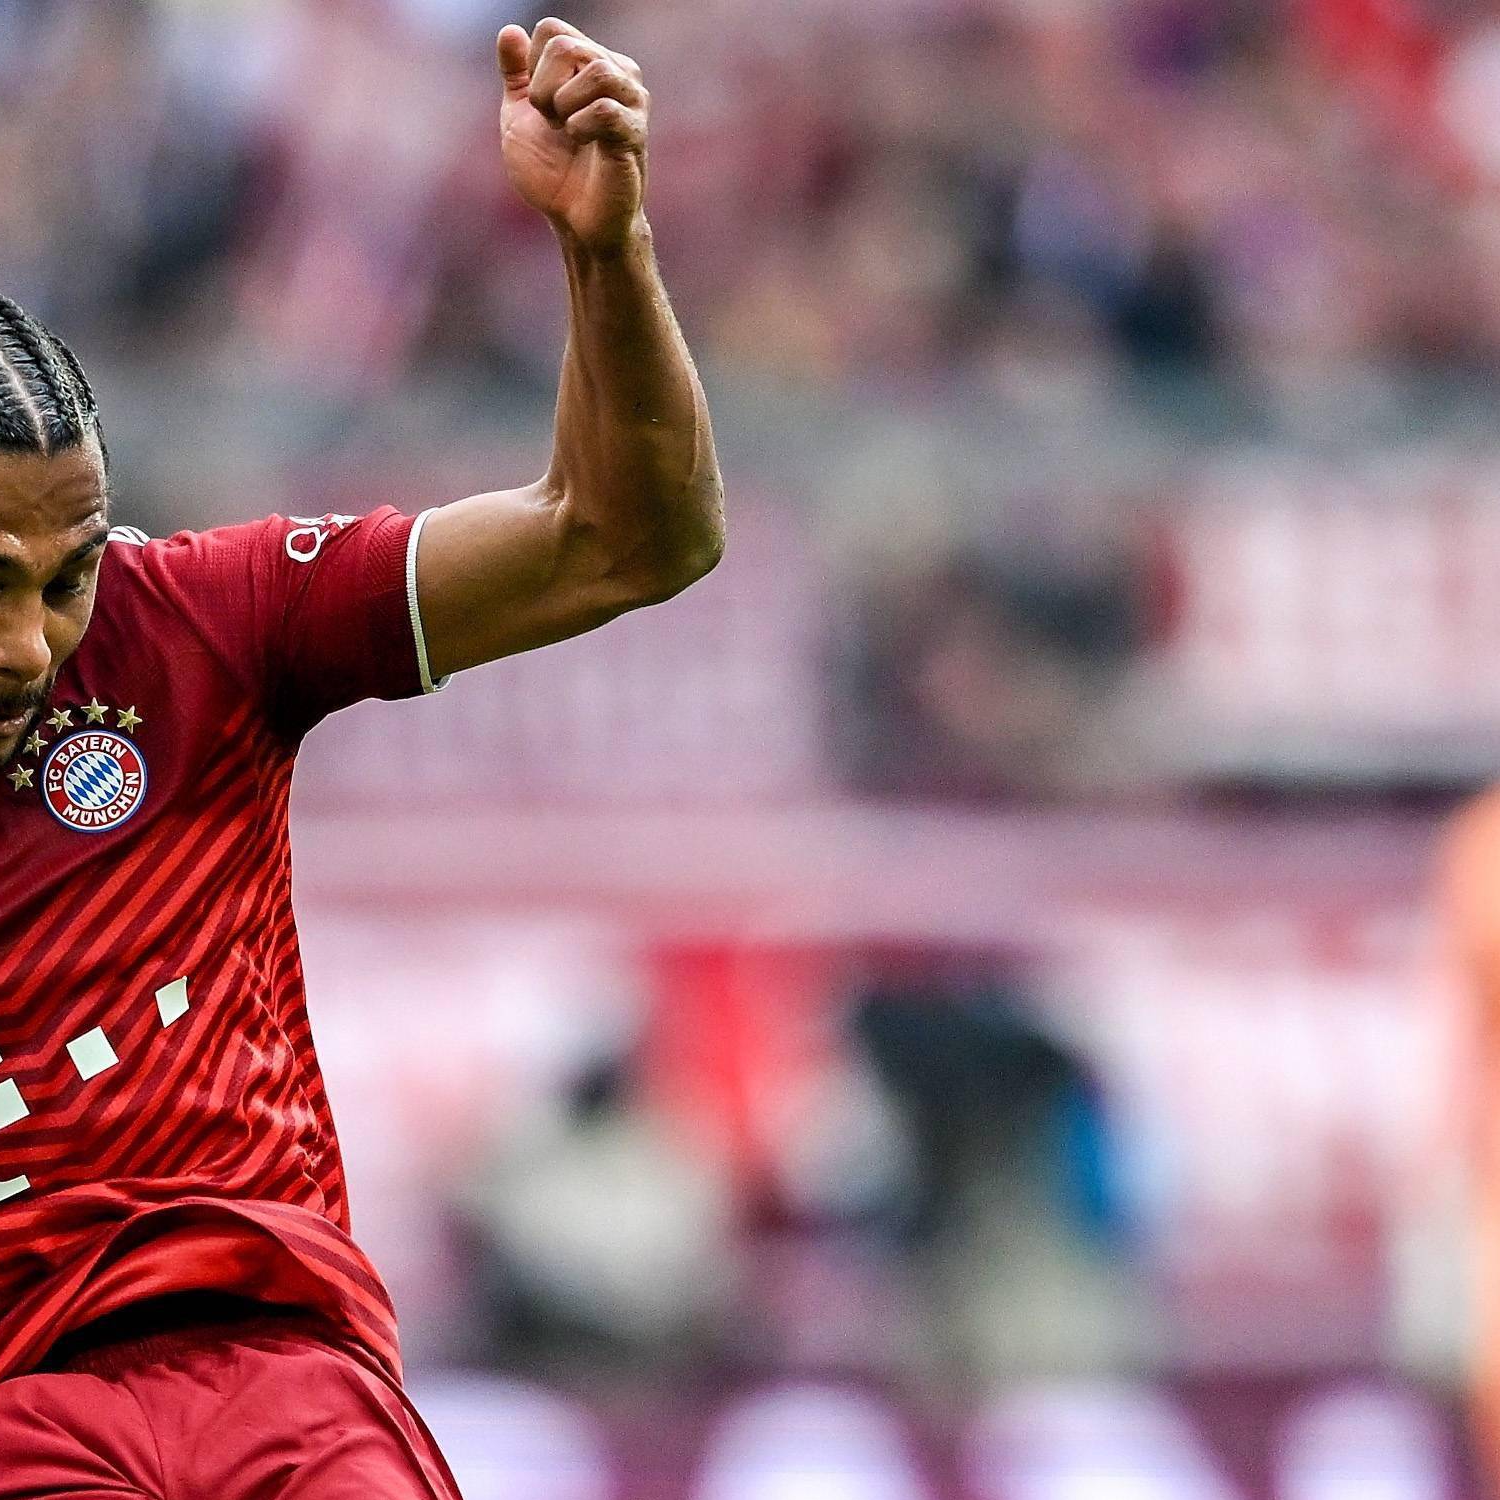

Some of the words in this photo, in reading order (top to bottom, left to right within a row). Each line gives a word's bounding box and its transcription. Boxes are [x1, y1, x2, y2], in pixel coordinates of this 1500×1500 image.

[49, 768, 63, 792] FC
[56, 736, 128, 766] BAYERN
[62, 772, 140, 825] MÜNCHEN
